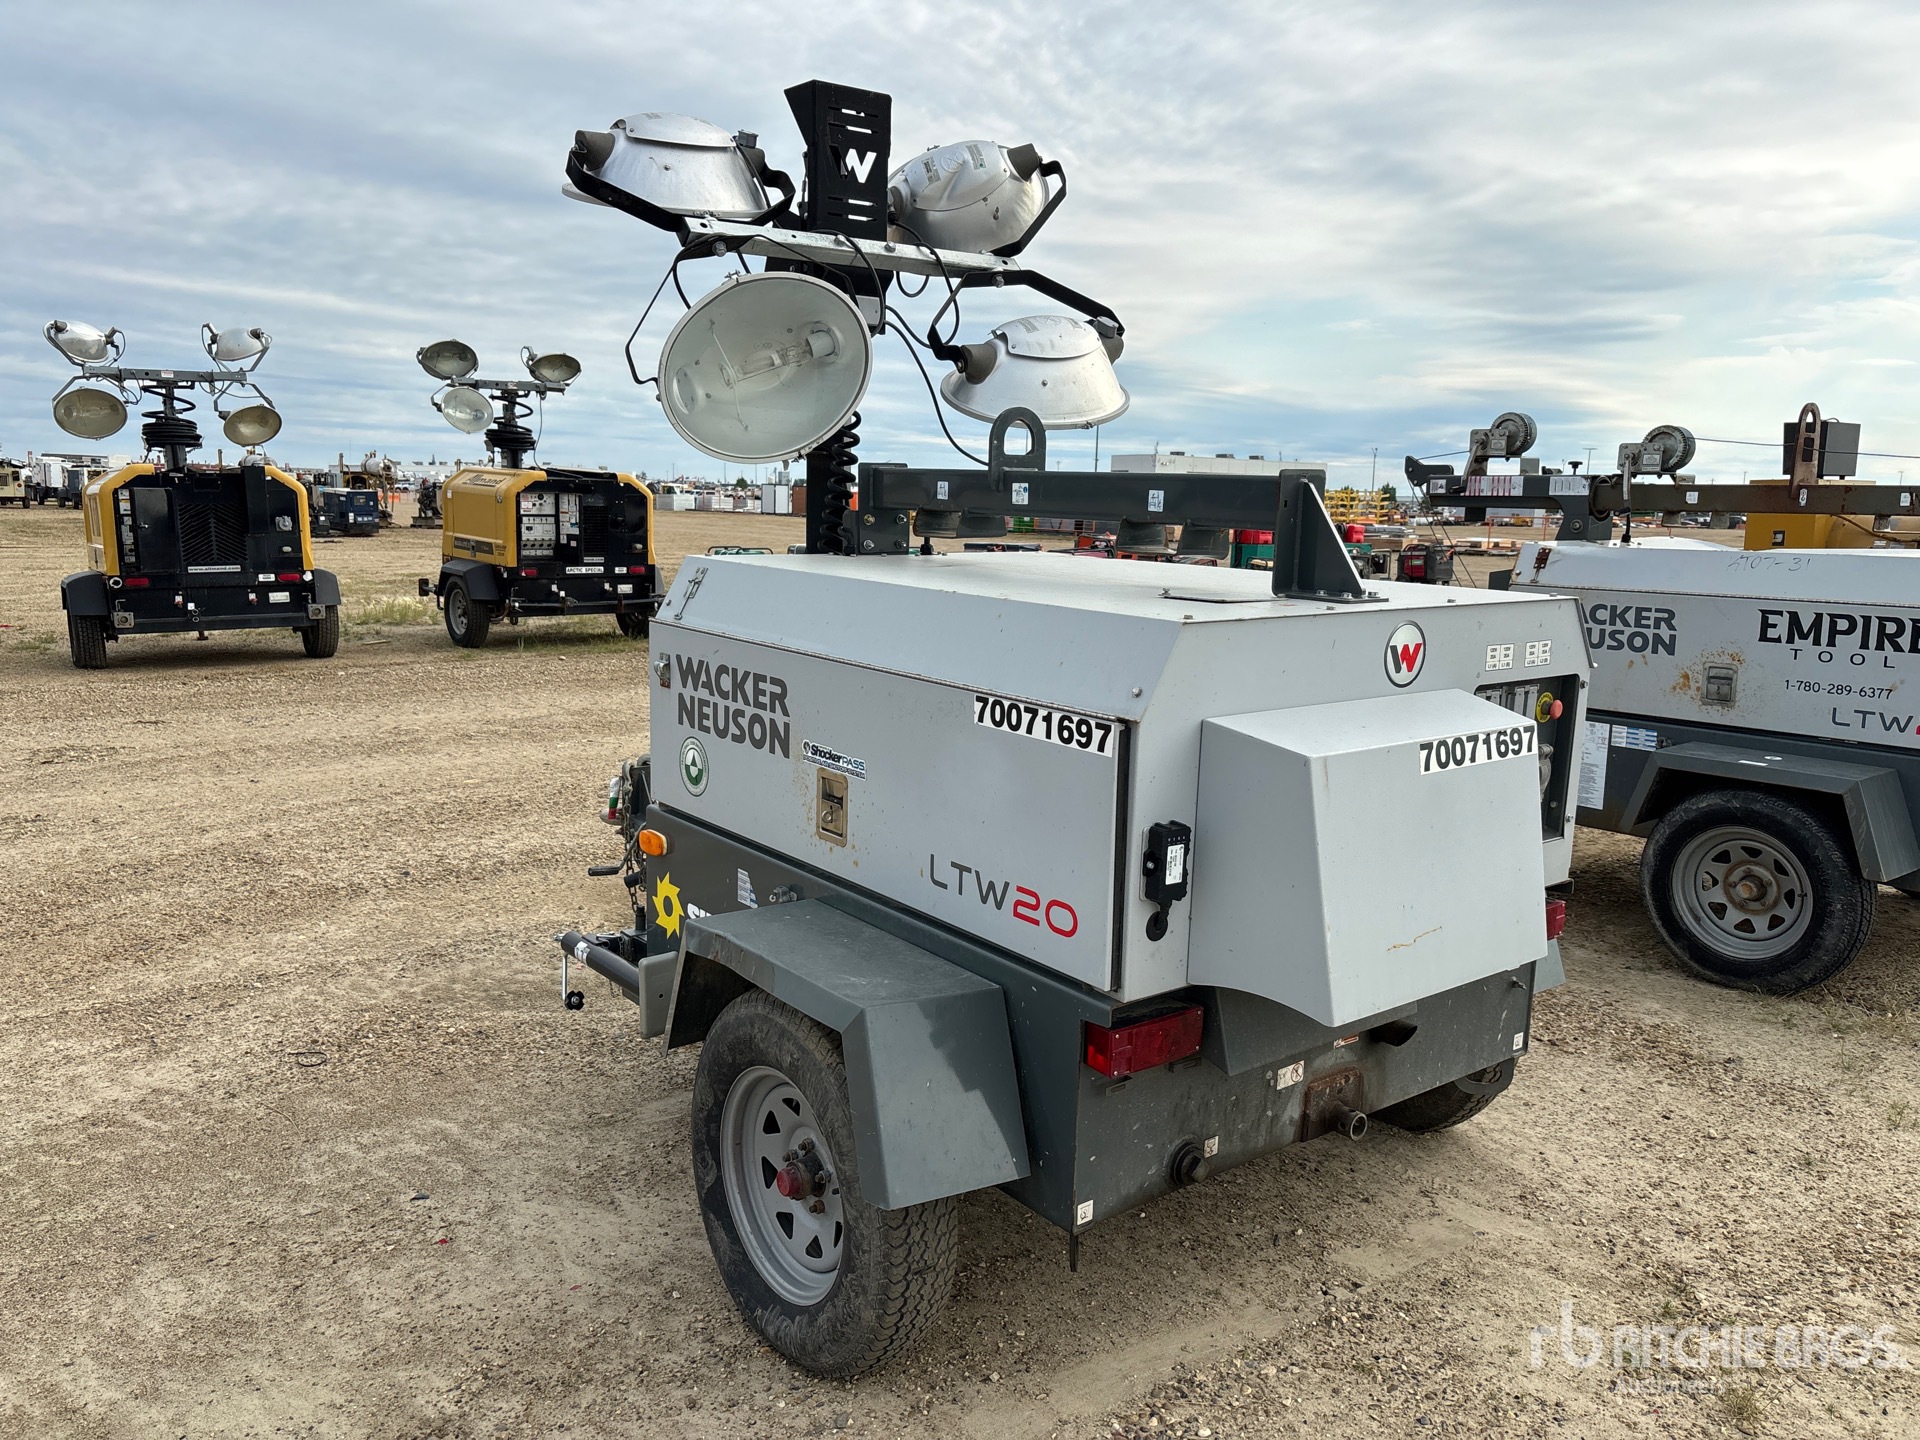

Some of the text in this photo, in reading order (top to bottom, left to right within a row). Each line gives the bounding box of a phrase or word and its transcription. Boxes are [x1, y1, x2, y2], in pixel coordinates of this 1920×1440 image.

[1789, 648, 1896, 669] TOOL
[675, 653, 790, 718] WACKER
[1784, 679, 1893, 700] 1-780-289-6377
[677, 692, 790, 760] NEUSON
[975, 695, 1112, 754] 70071697
[1831, 706, 1920, 735] LTW
[1420, 725, 1535, 773] 70071697
[930, 853, 1079, 938] LTW20
